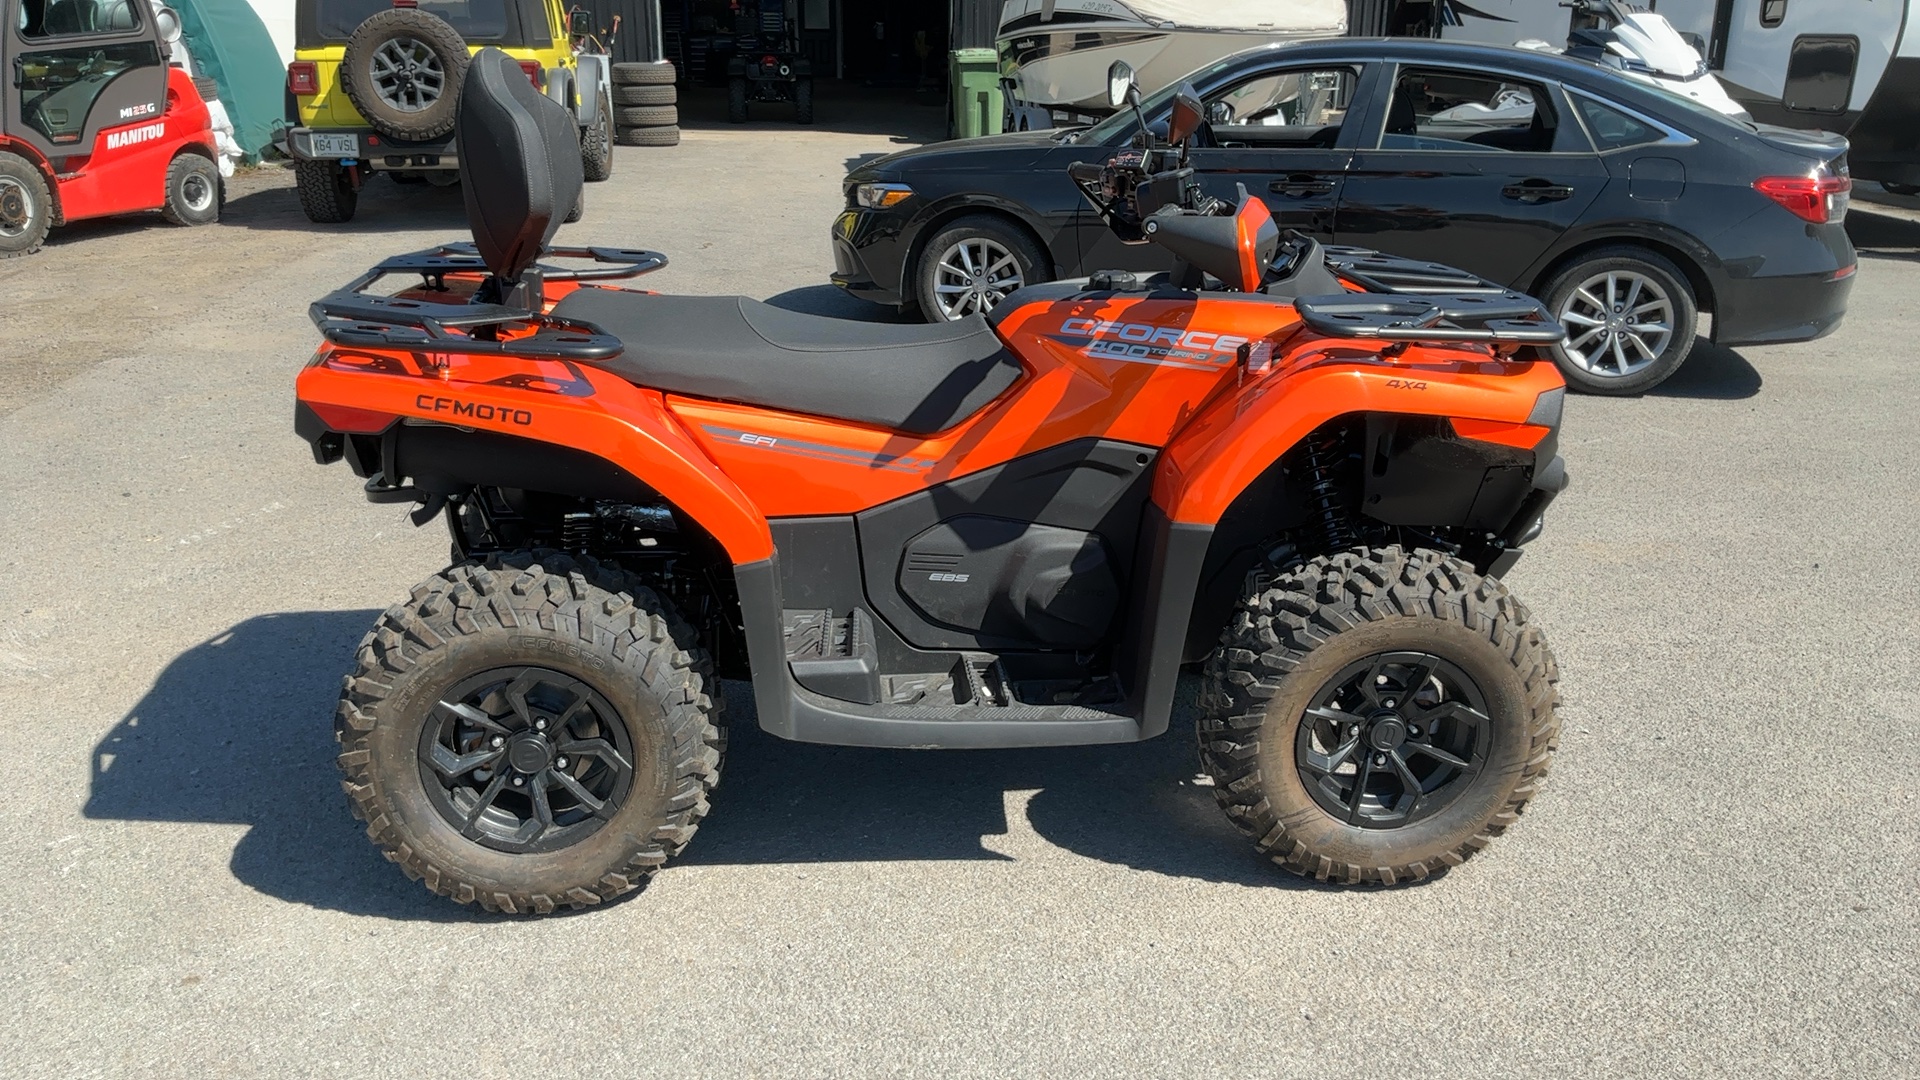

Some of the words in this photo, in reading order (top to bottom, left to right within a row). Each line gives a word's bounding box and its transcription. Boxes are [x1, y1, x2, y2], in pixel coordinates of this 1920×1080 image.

[107, 122, 165, 150] MANITOU
[337, 139, 357, 152] VSL
[1059, 317, 1249, 352] CFORCE
[1086, 340, 1153, 358] 400
[1151, 348, 1208, 361] TOURING
[416, 394, 532, 426] CFMOTO
[739, 433, 778, 447] EFI
[928, 573, 970, 583] EBS
[521, 637, 606, 670] CFMOTO
